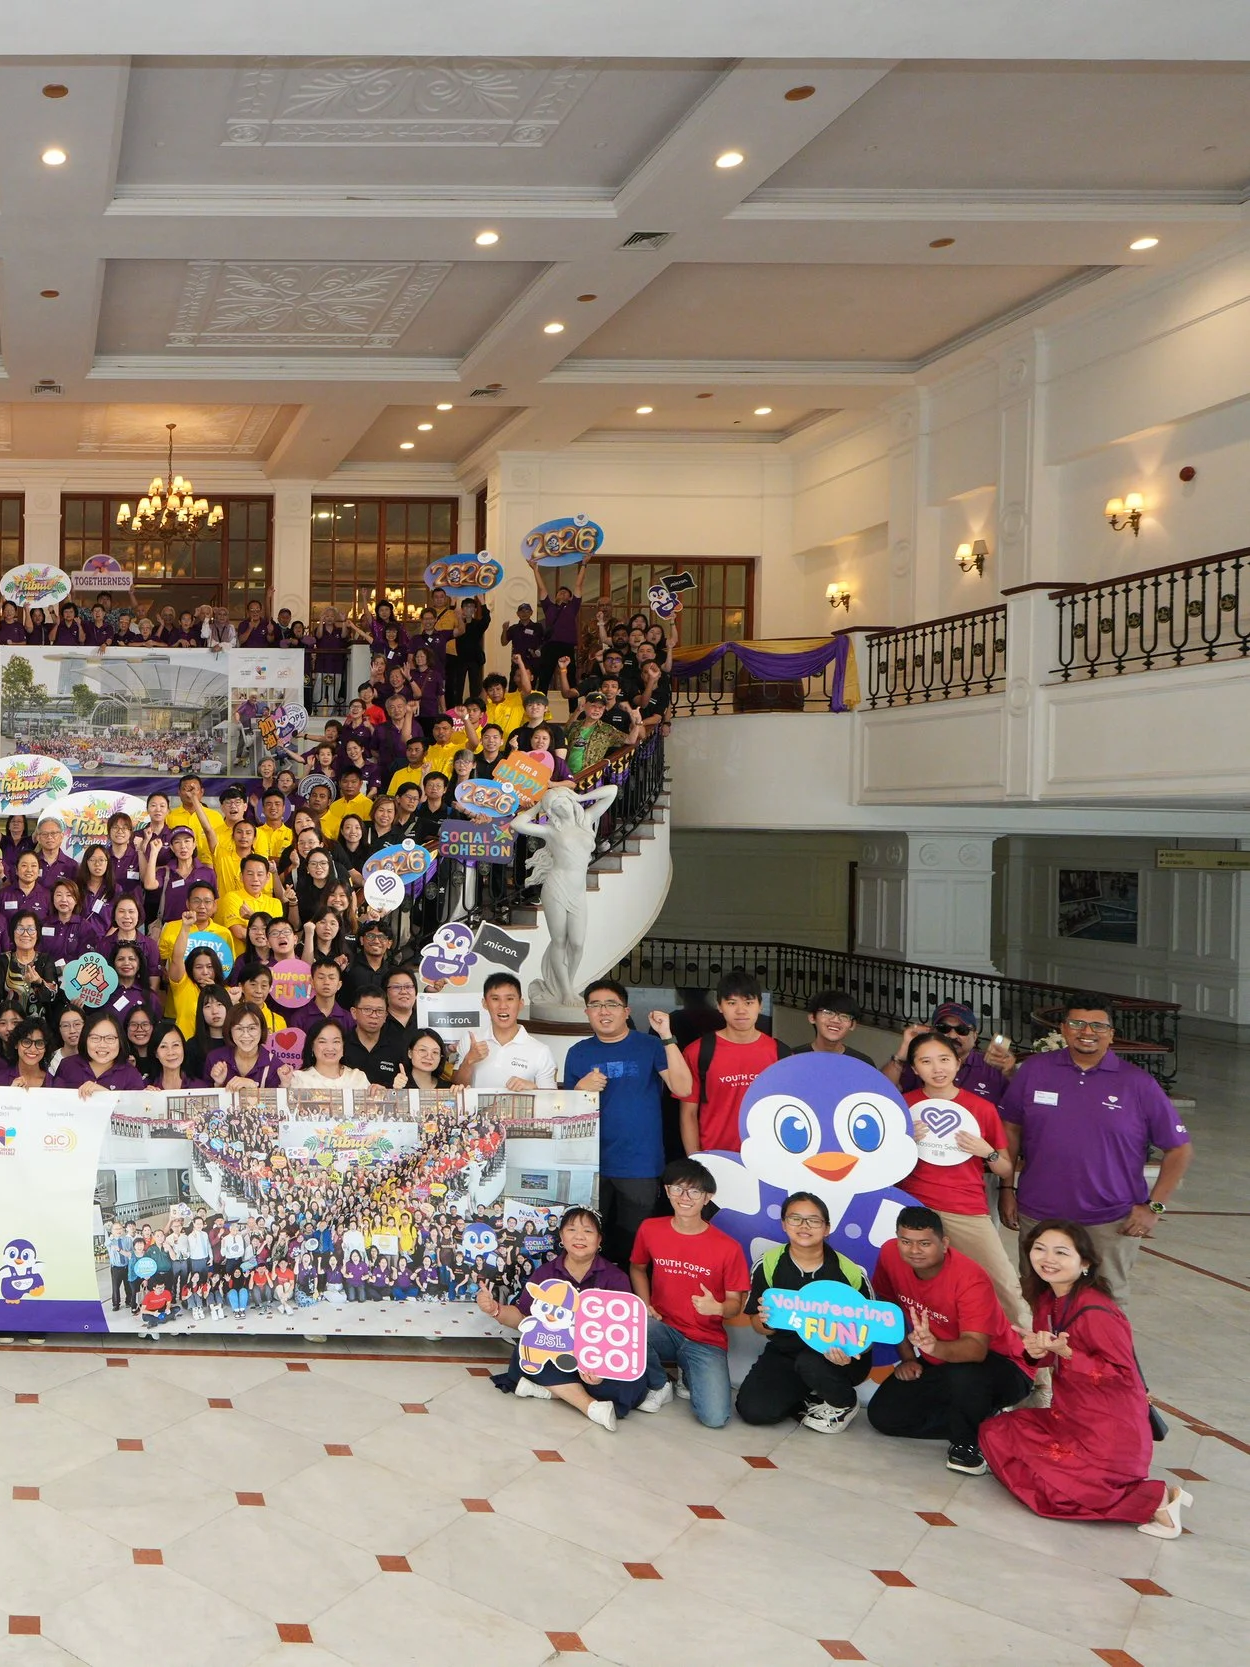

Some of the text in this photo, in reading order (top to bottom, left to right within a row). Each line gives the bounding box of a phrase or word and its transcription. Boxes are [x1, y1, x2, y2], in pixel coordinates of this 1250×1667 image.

[527, 526, 598, 560] 2026
[74, 577, 131, 586] TOGETHERNESS
[431, 562, 498, 588] 2026
[258, 716, 278, 750] 加油
[519, 763, 532, 773] am
[496, 764, 543, 796] HAPPY
[461, 782, 516, 814] 2026
[79, 835, 107, 846] Seniors
[441, 831, 490, 844] SOCIAL
[441, 845, 511, 857] COHESION
[188, 938, 223, 951] EVERY
[483, 940, 518, 958] micron
[80, 993, 102, 1006] FIVE
[82, 987, 103, 999] HIGH
[275, 984, 312, 999] FUN!
[435, 1015, 472, 1025] micron
[719, 1074, 748, 1083] YOUTH
[917, 1140, 943, 1149] lossom
[654, 1258, 711, 1276] YOUTH CORPS
[581, 1295, 639, 1323] GO!
[770, 1293, 895, 1326] Volunteering
[580, 1321, 639, 1349] GO!
[788, 1312, 869, 1348] is FUN!
[535, 1333, 566, 1349] BSL
[579, 1346, 638, 1375] GO!
